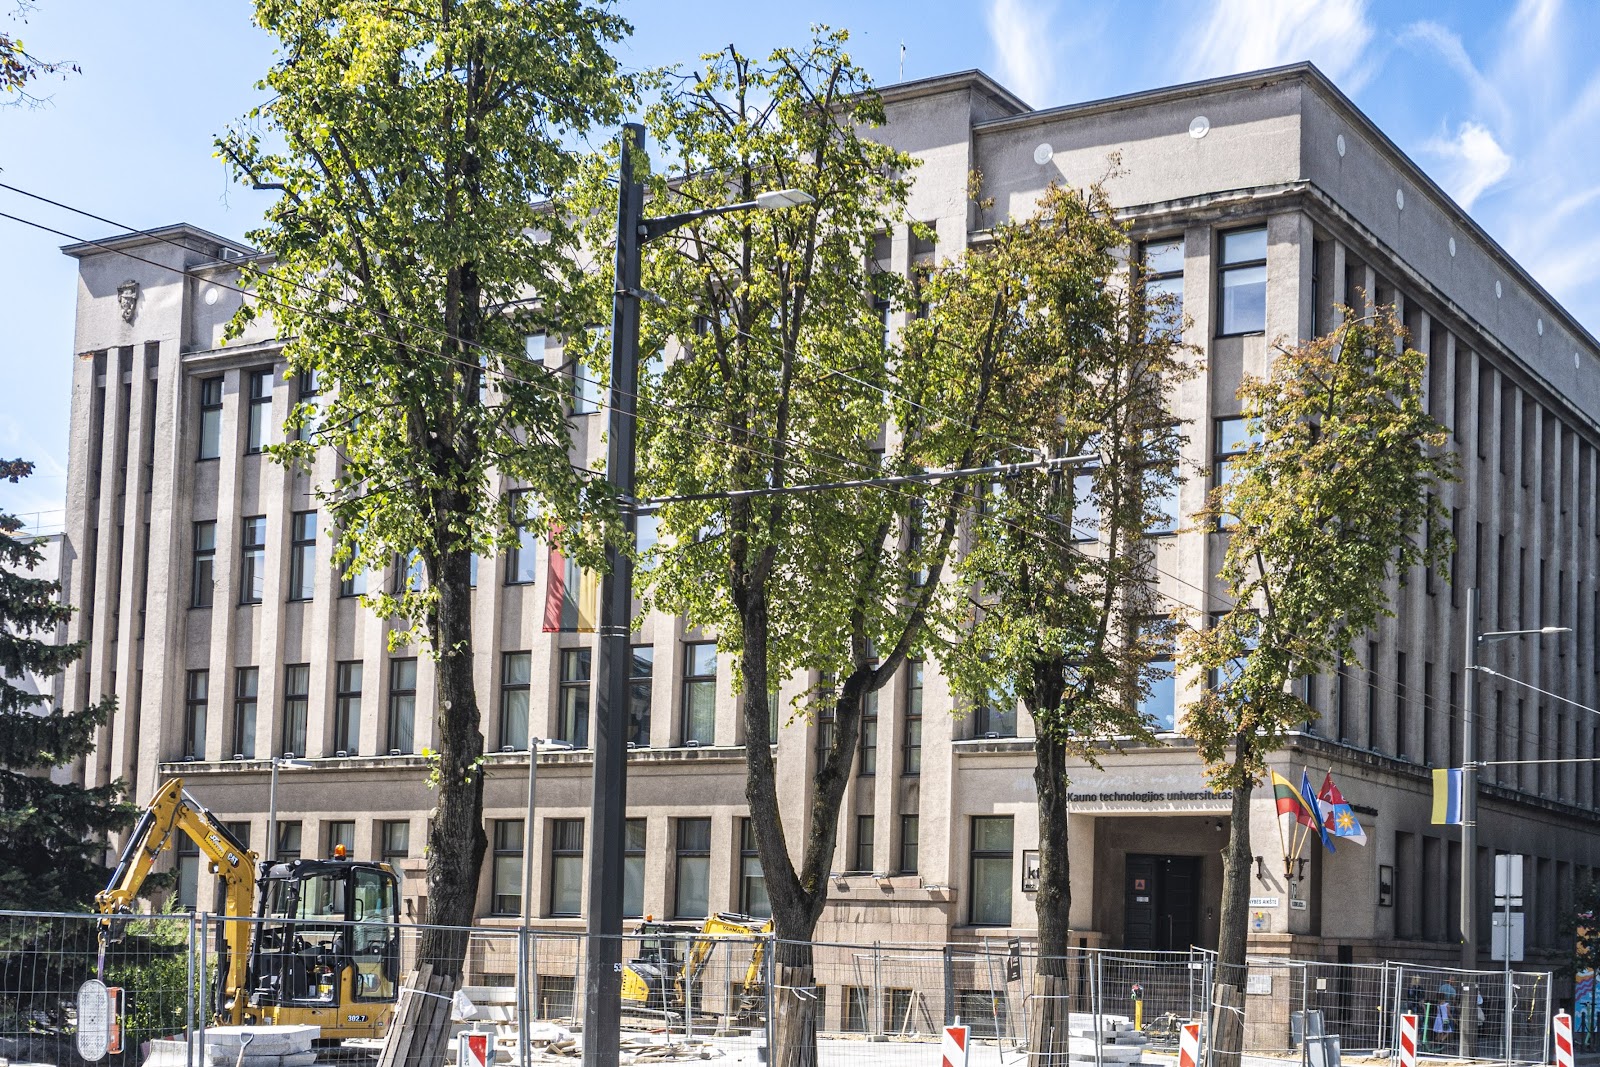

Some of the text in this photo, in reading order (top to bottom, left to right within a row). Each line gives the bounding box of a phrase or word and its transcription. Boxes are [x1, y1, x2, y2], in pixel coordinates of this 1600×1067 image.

[1067, 790, 1233, 803] Kauno technologijos universitetas
[227, 852, 239, 866] CAT
[347, 1014, 366, 1022] 302.7
